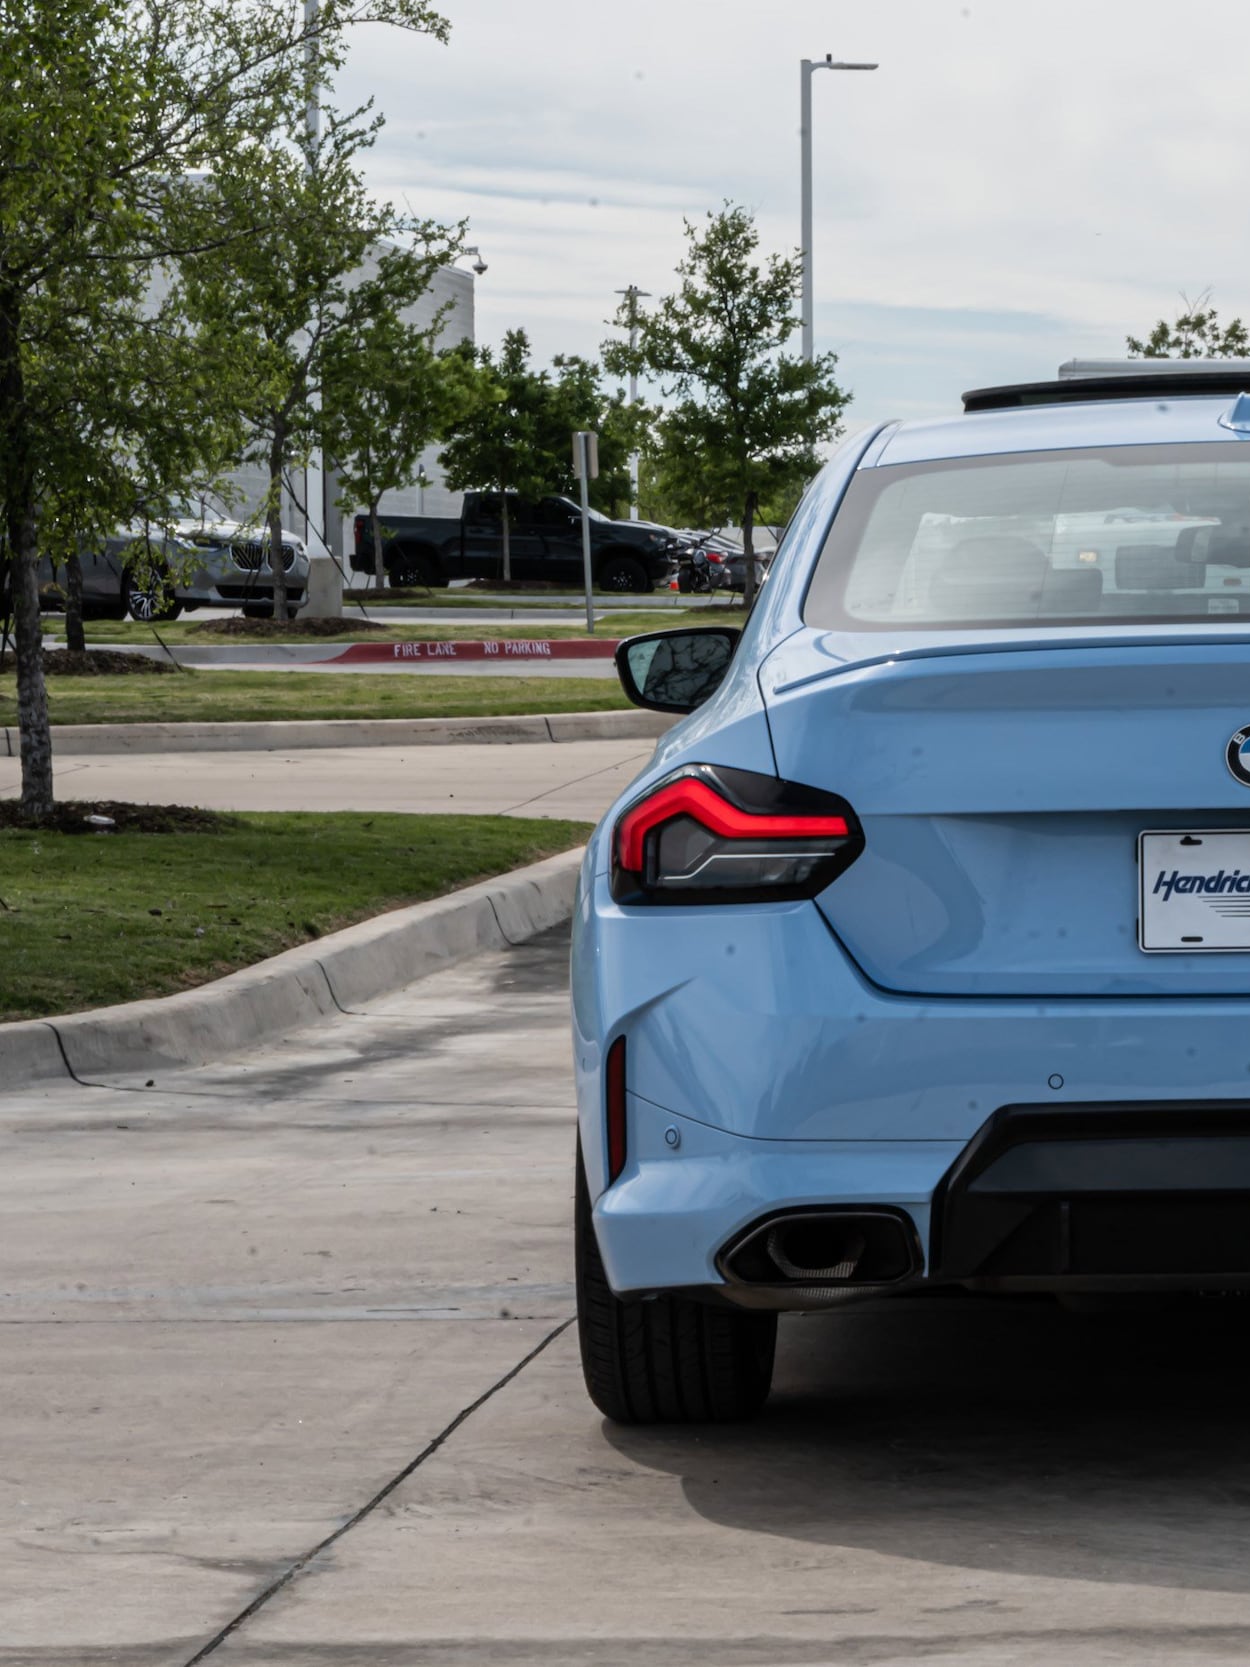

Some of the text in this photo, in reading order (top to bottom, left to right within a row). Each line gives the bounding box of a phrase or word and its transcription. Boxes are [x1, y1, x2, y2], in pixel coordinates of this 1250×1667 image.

[394, 641, 551, 657] FIRE LANE NO PARKING
